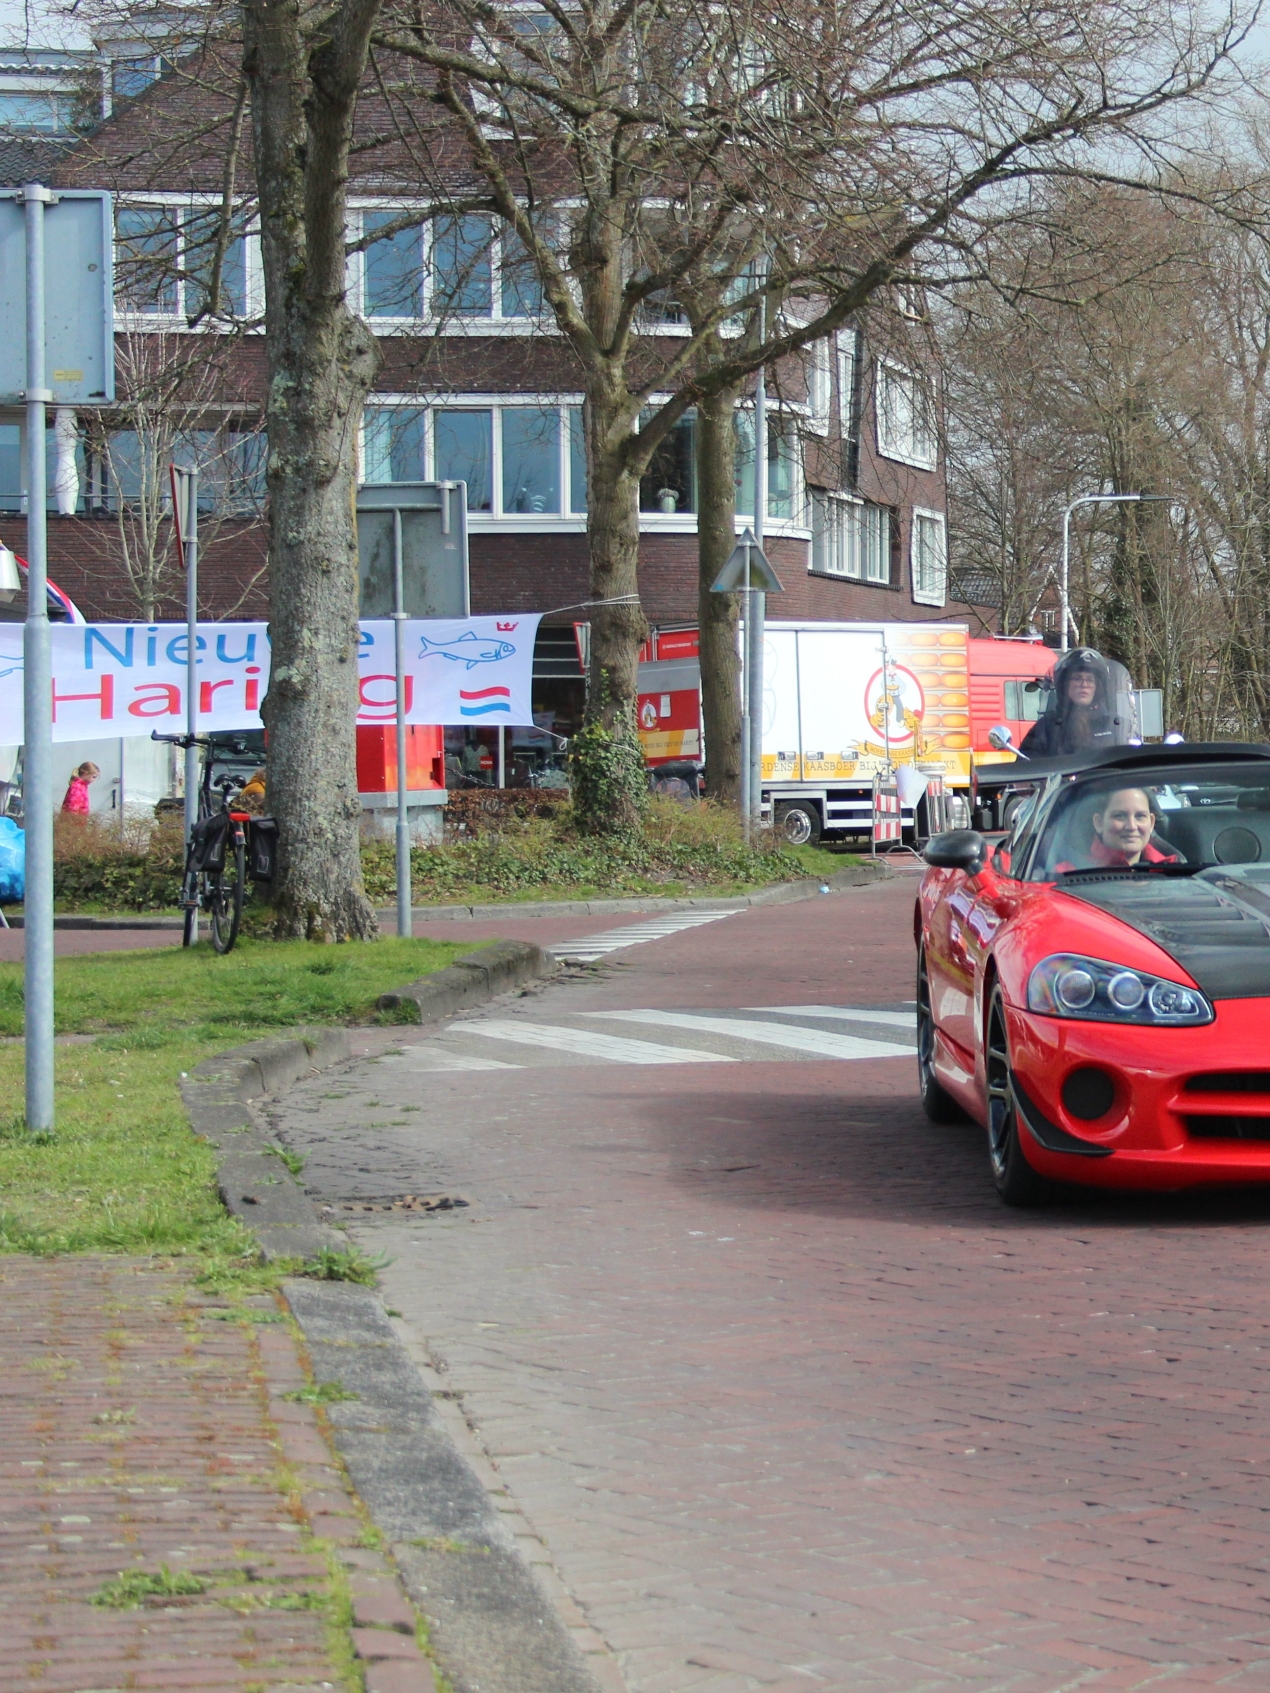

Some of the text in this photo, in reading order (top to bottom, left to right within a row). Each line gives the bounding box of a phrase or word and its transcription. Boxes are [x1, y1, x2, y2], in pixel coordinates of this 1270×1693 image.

[52, 666, 413, 724] Harig
[761, 762, 800, 772] RDENSE
[804, 761, 855, 771] KAASBOER
